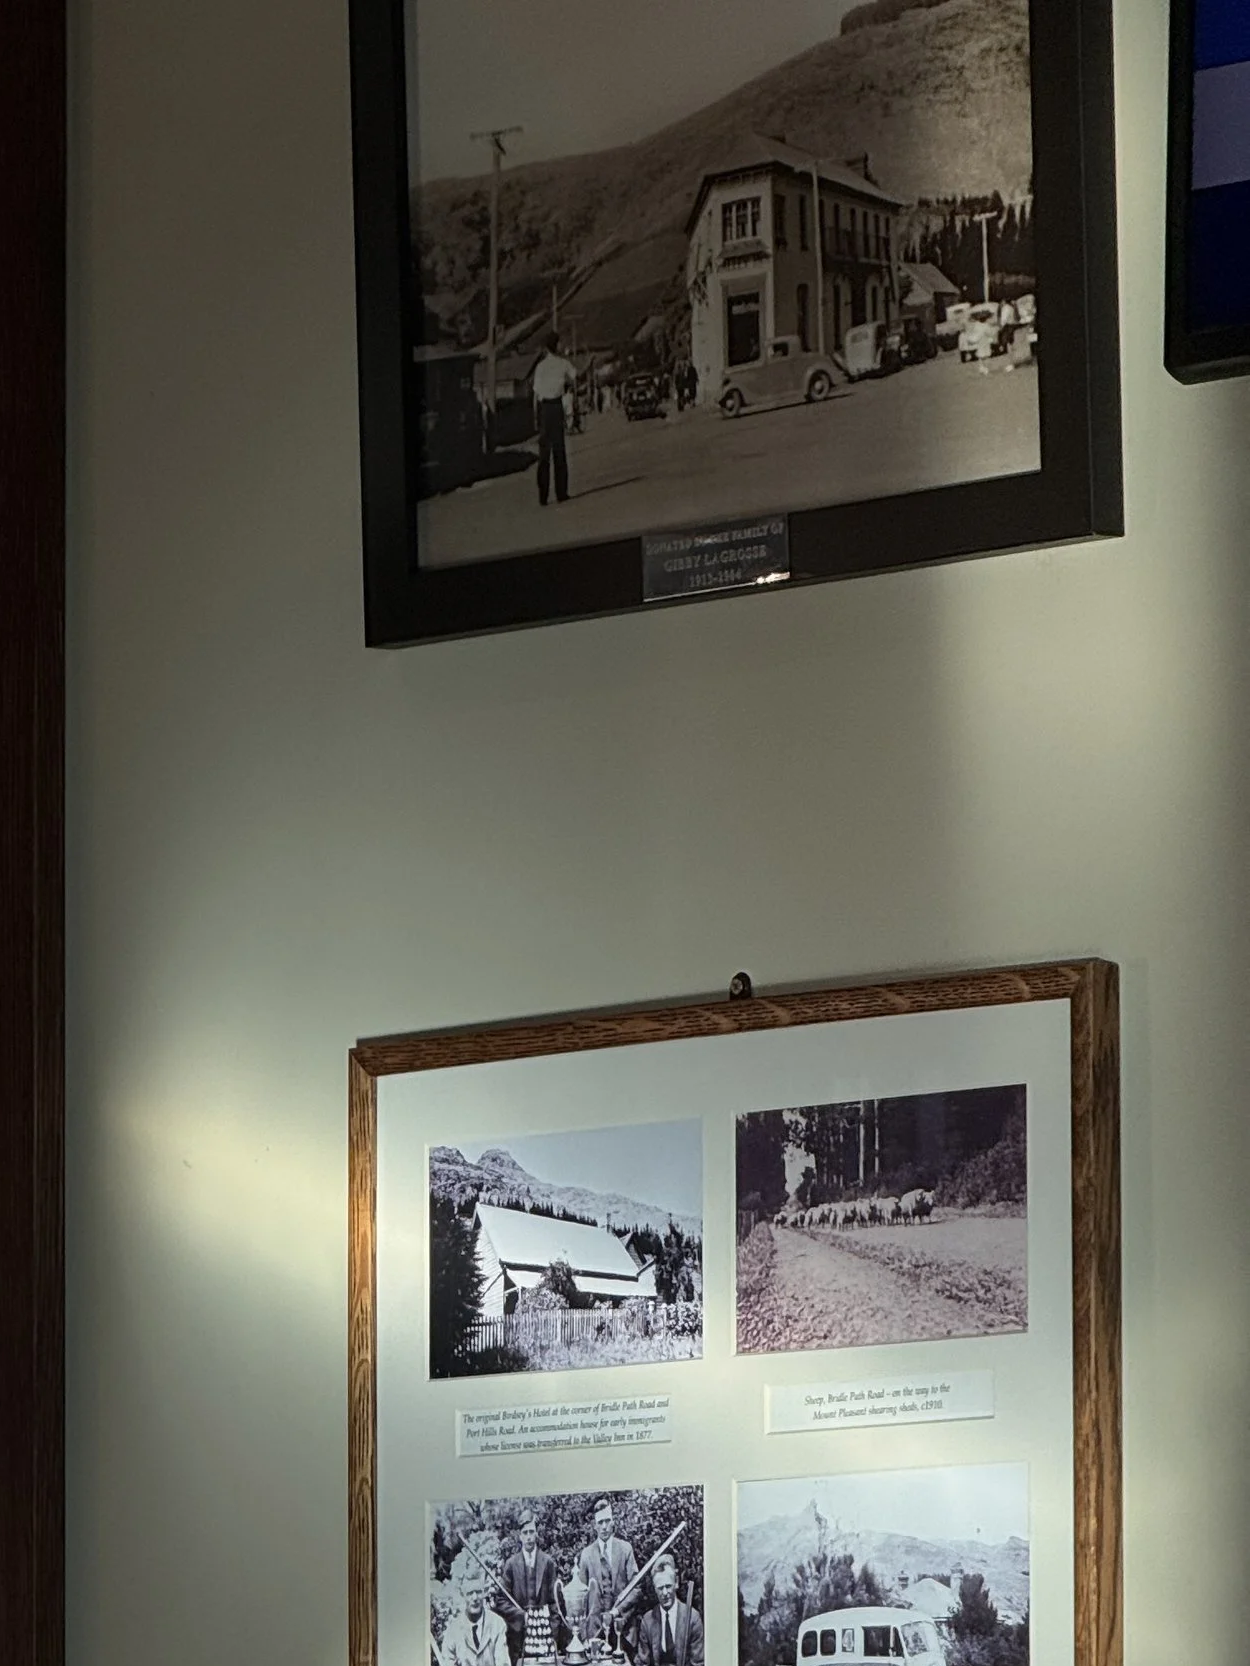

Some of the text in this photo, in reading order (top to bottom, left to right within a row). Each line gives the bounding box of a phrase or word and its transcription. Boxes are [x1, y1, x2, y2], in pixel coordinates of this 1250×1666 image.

[731, 525, 769, 541] FAMILY
[828, 1392, 848, 1403] Bridle
[849, 1389, 865, 1401] Path
[867, 1388, 885, 1400] Road
[892, 1389, 901, 1398] on
[902, 1386, 913, 1397] the
[915, 1387, 929, 1397] way
[930, 1385, 938, 1394] to
[939, 1382, 950, 1393] the
[462, 1413, 474, 1424] The
[476, 1411, 500, 1424] original
[533, 1407, 551, 1417] Hotel
[552, 1407, 558, 1416] at
[560, 1405, 570, 1416] the
[571, 1406, 592, 1415] corner
[593, 1403, 600, 1416] of
[601, 1402, 620, 1412] Bridle
[622, 1400, 637, 1411] Path
[639, 1399, 656, 1409] Road
[657, 1398, 669, 1408] and
[813, 1410, 837, 1420] Mount
[838, 1407, 867, 1418] Pleasant
[868, 1404, 897, 1417] shearing
[466, 1428, 480, 1438] Port
[481, 1426, 497, 1437] Hills
[518, 1424, 528, 1434] An
[530, 1421, 579, 1433] accommodation
[580, 1420, 598, 1429] house
[598, 1418, 609, 1431] for
[610, 1416, 626, 1429] early
[480, 1442, 499, 1452] whose
[522, 1441, 536, 1449] was
[573, 1436, 580, 1444] to
[581, 1434, 592, 1444] the
[593, 1433, 612, 1445] Valley
[613, 1432, 625, 1442] Inn
[626, 1433, 634, 1441] in
